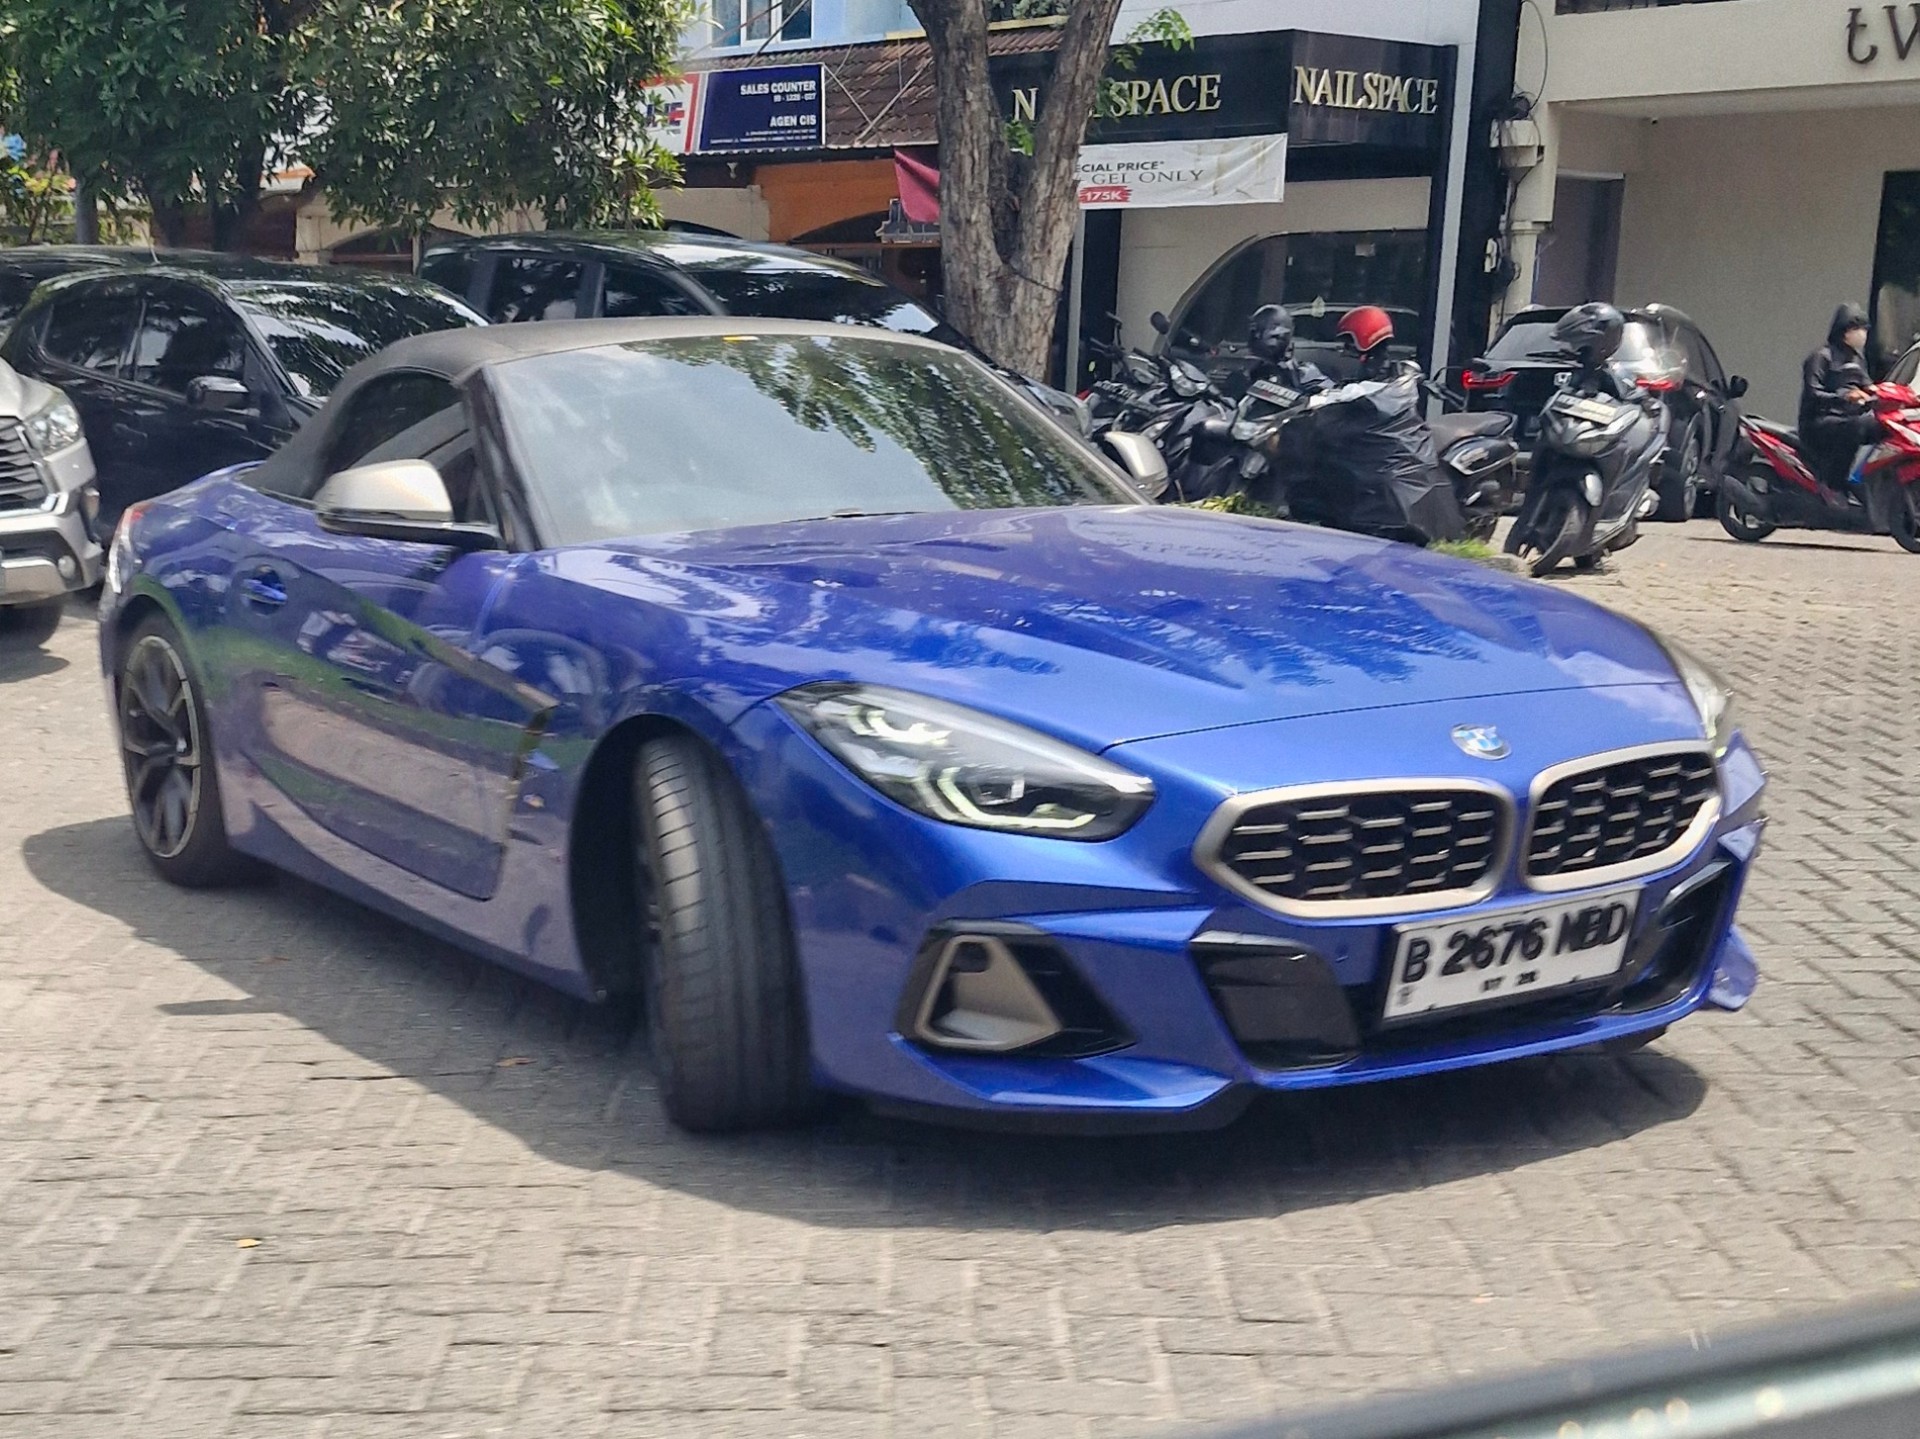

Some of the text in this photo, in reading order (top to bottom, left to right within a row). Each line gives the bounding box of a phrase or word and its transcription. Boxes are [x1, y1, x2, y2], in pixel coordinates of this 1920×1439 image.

[740, 80, 816, 95] SALES COUNTER
[1293, 66, 1438, 114] NAILSPACE
[1011, 74, 1222, 121] NSPACE
[769, 114, 817, 128] AGEN CIS
[1091, 170, 1205, 185] GEL ONLY
[1084, 191, 1122, 202] 175K
[1402, 937, 1431, 983] B
[1440, 916, 1549, 977] 2676
